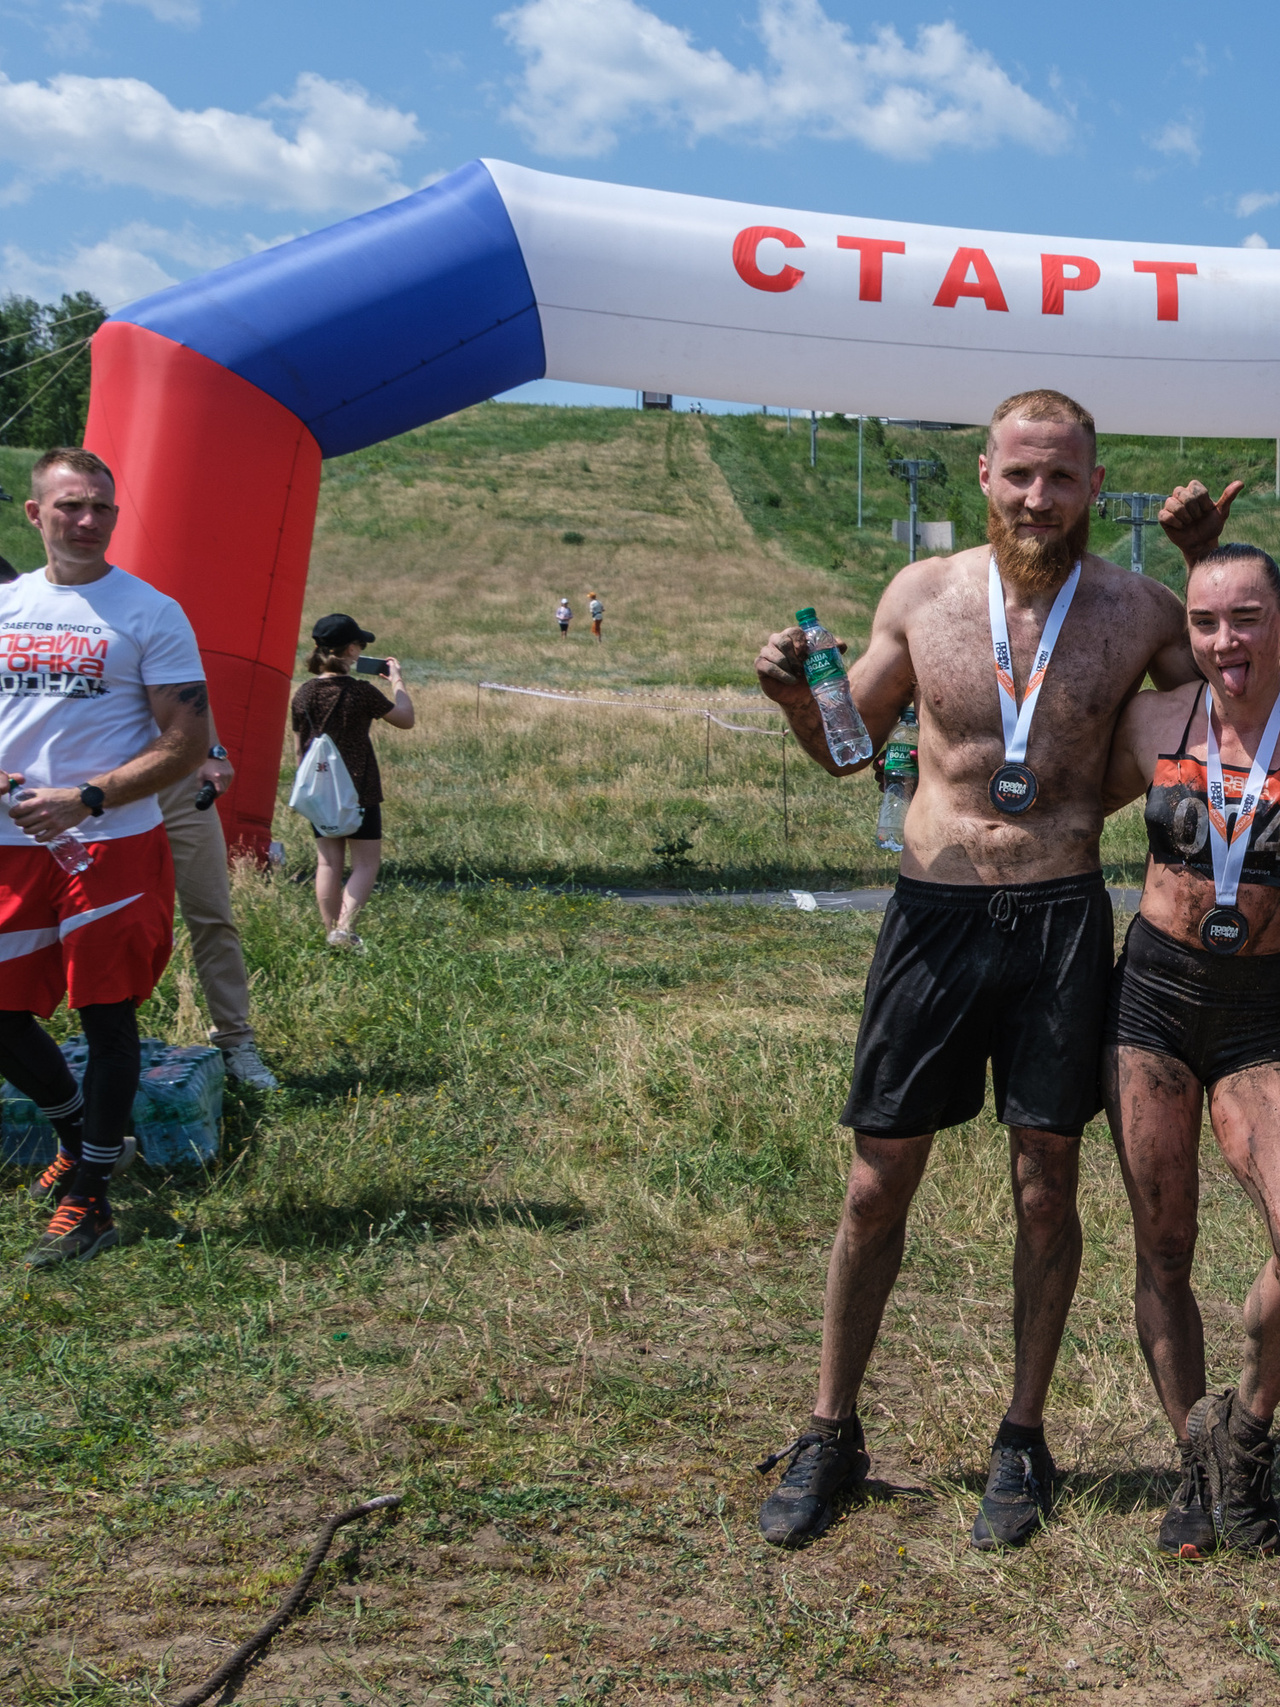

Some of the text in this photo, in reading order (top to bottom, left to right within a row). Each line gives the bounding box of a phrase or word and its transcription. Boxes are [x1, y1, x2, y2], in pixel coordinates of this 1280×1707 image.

[732, 225, 1198, 322] СТАРТ
[2, 622, 102, 634] ЗАБЕГОВ МНОГО
[807, 659, 831, 673] ВОДА
